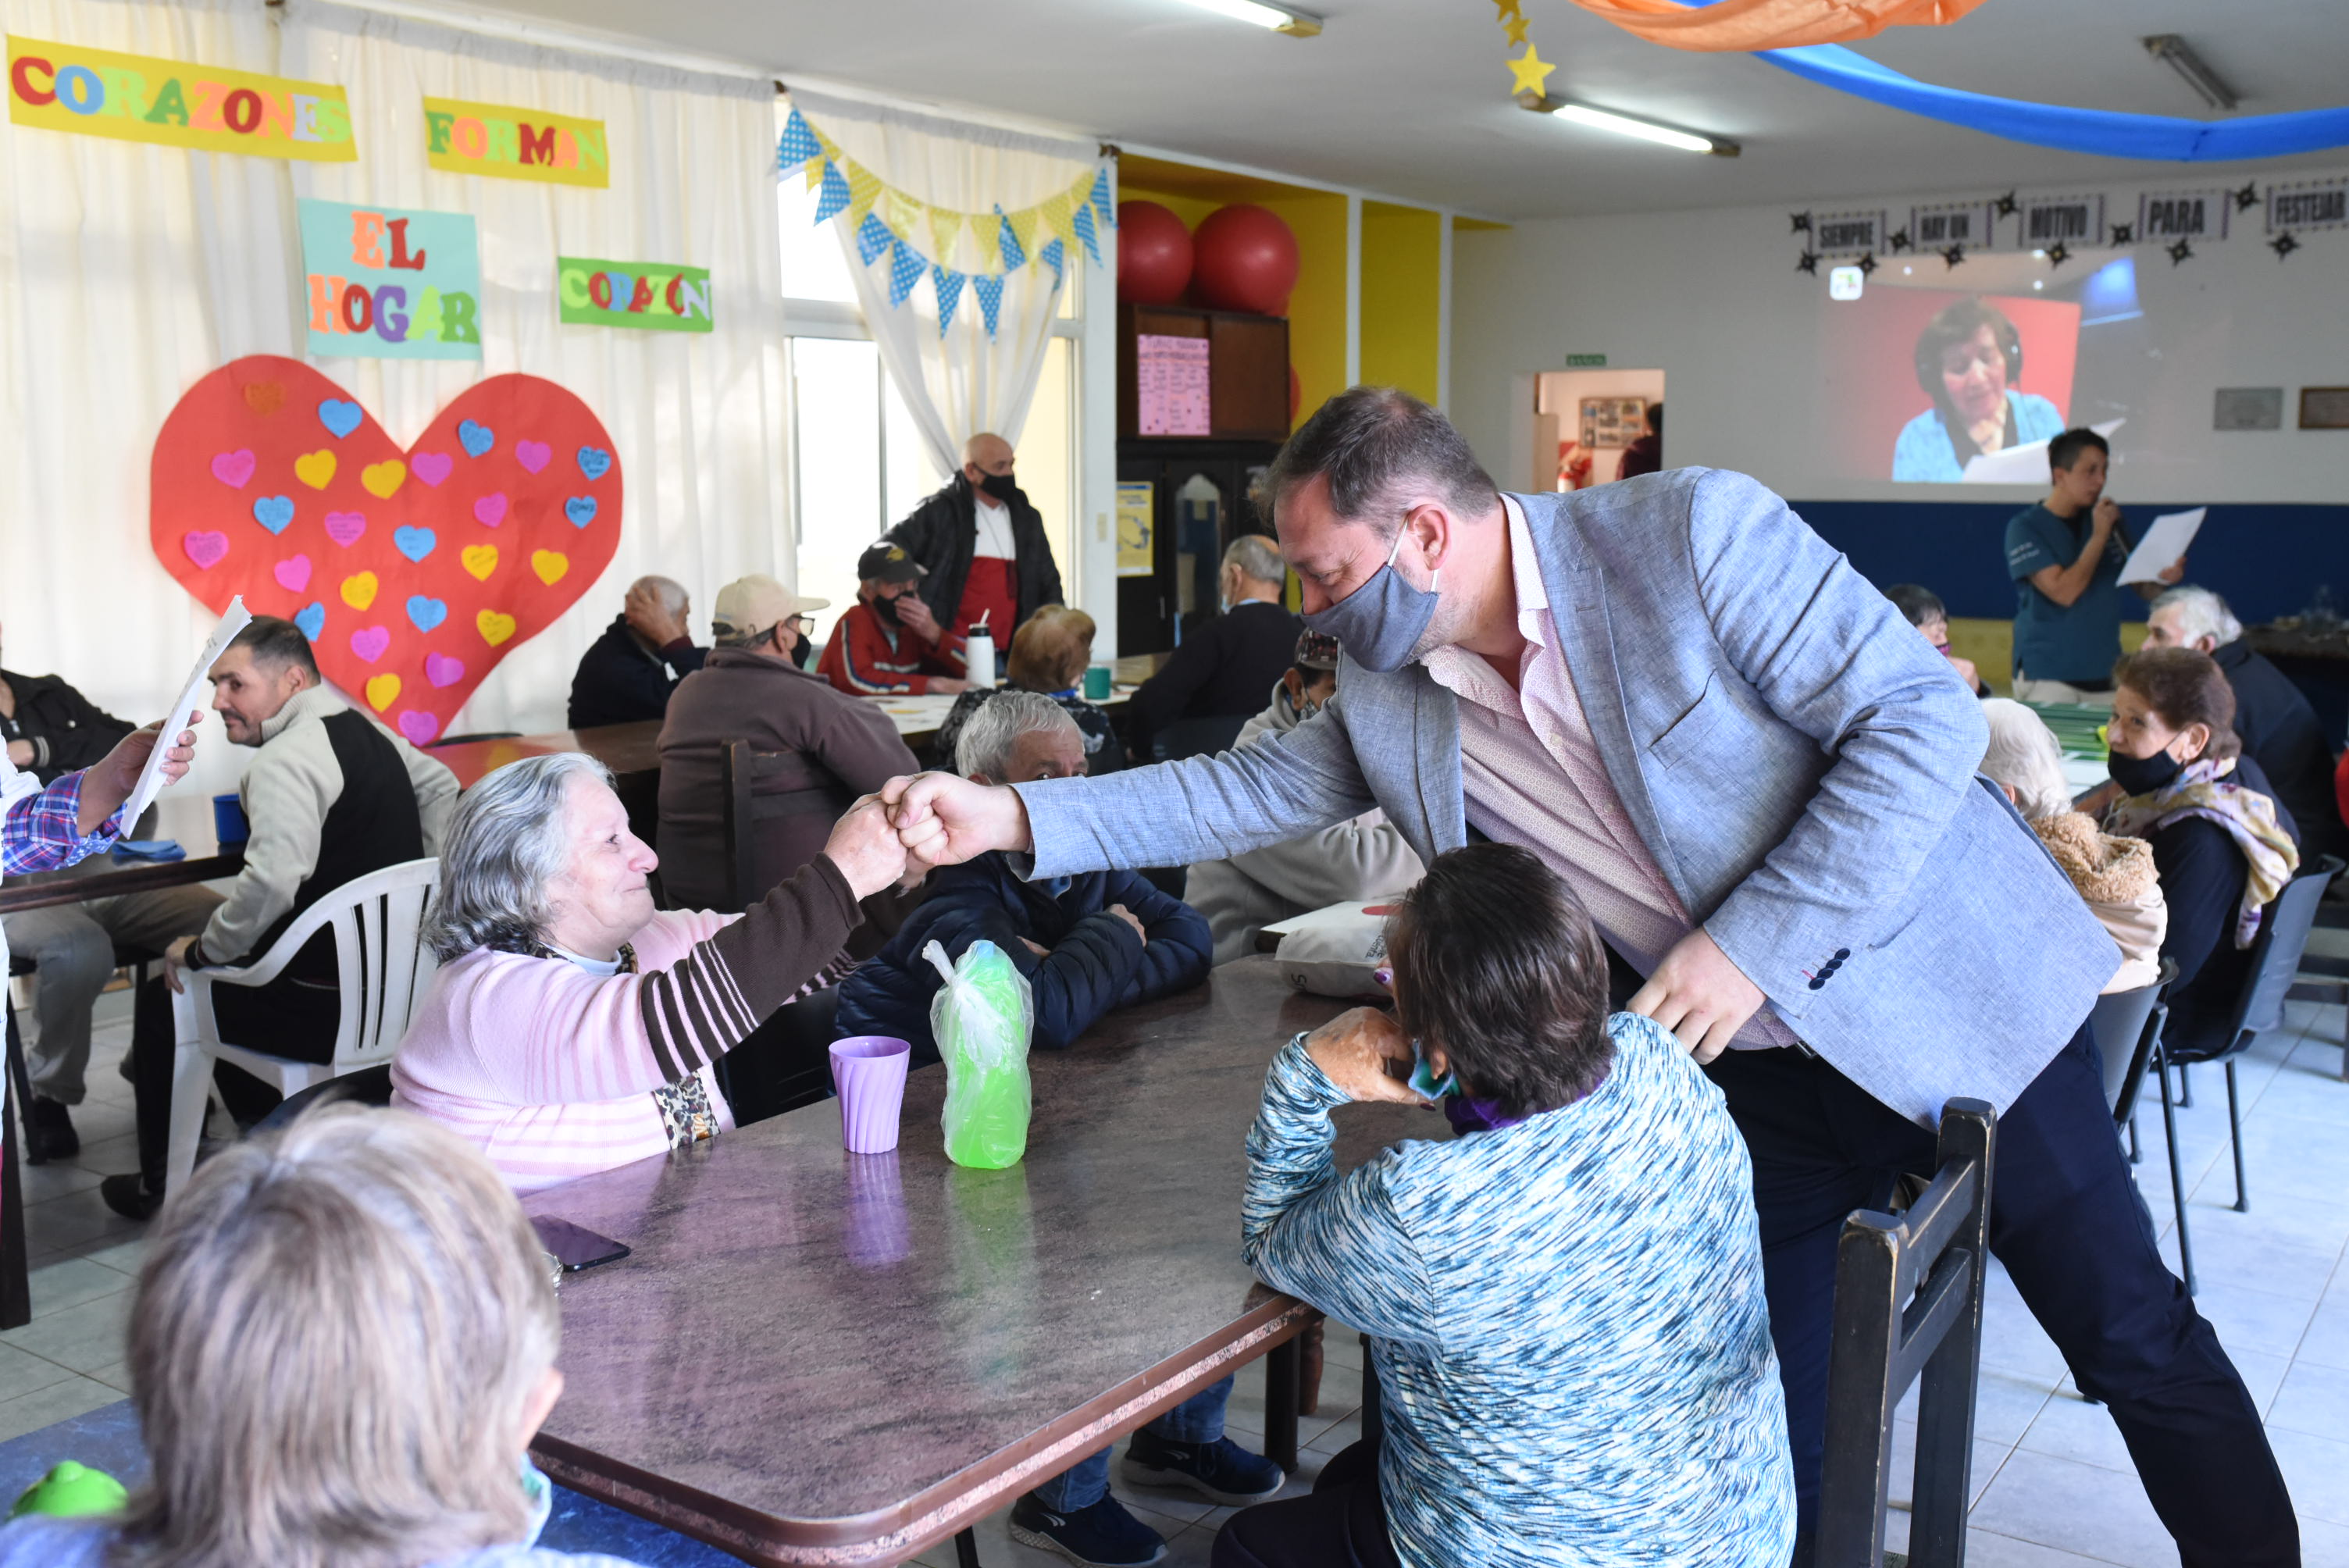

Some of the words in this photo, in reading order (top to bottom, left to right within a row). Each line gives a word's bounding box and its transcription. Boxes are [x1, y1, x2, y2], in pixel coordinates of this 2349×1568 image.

[12, 57, 351, 141] CORAZONES
[426, 111, 607, 172] FORMAN
[351, 211, 426, 271] EL
[1820, 222, 1873, 248] SIEMPRE
[2030, 205, 2087, 238] MOTIVO
[2149, 199, 2204, 234] PARA
[307, 273, 480, 344] HOGAR
